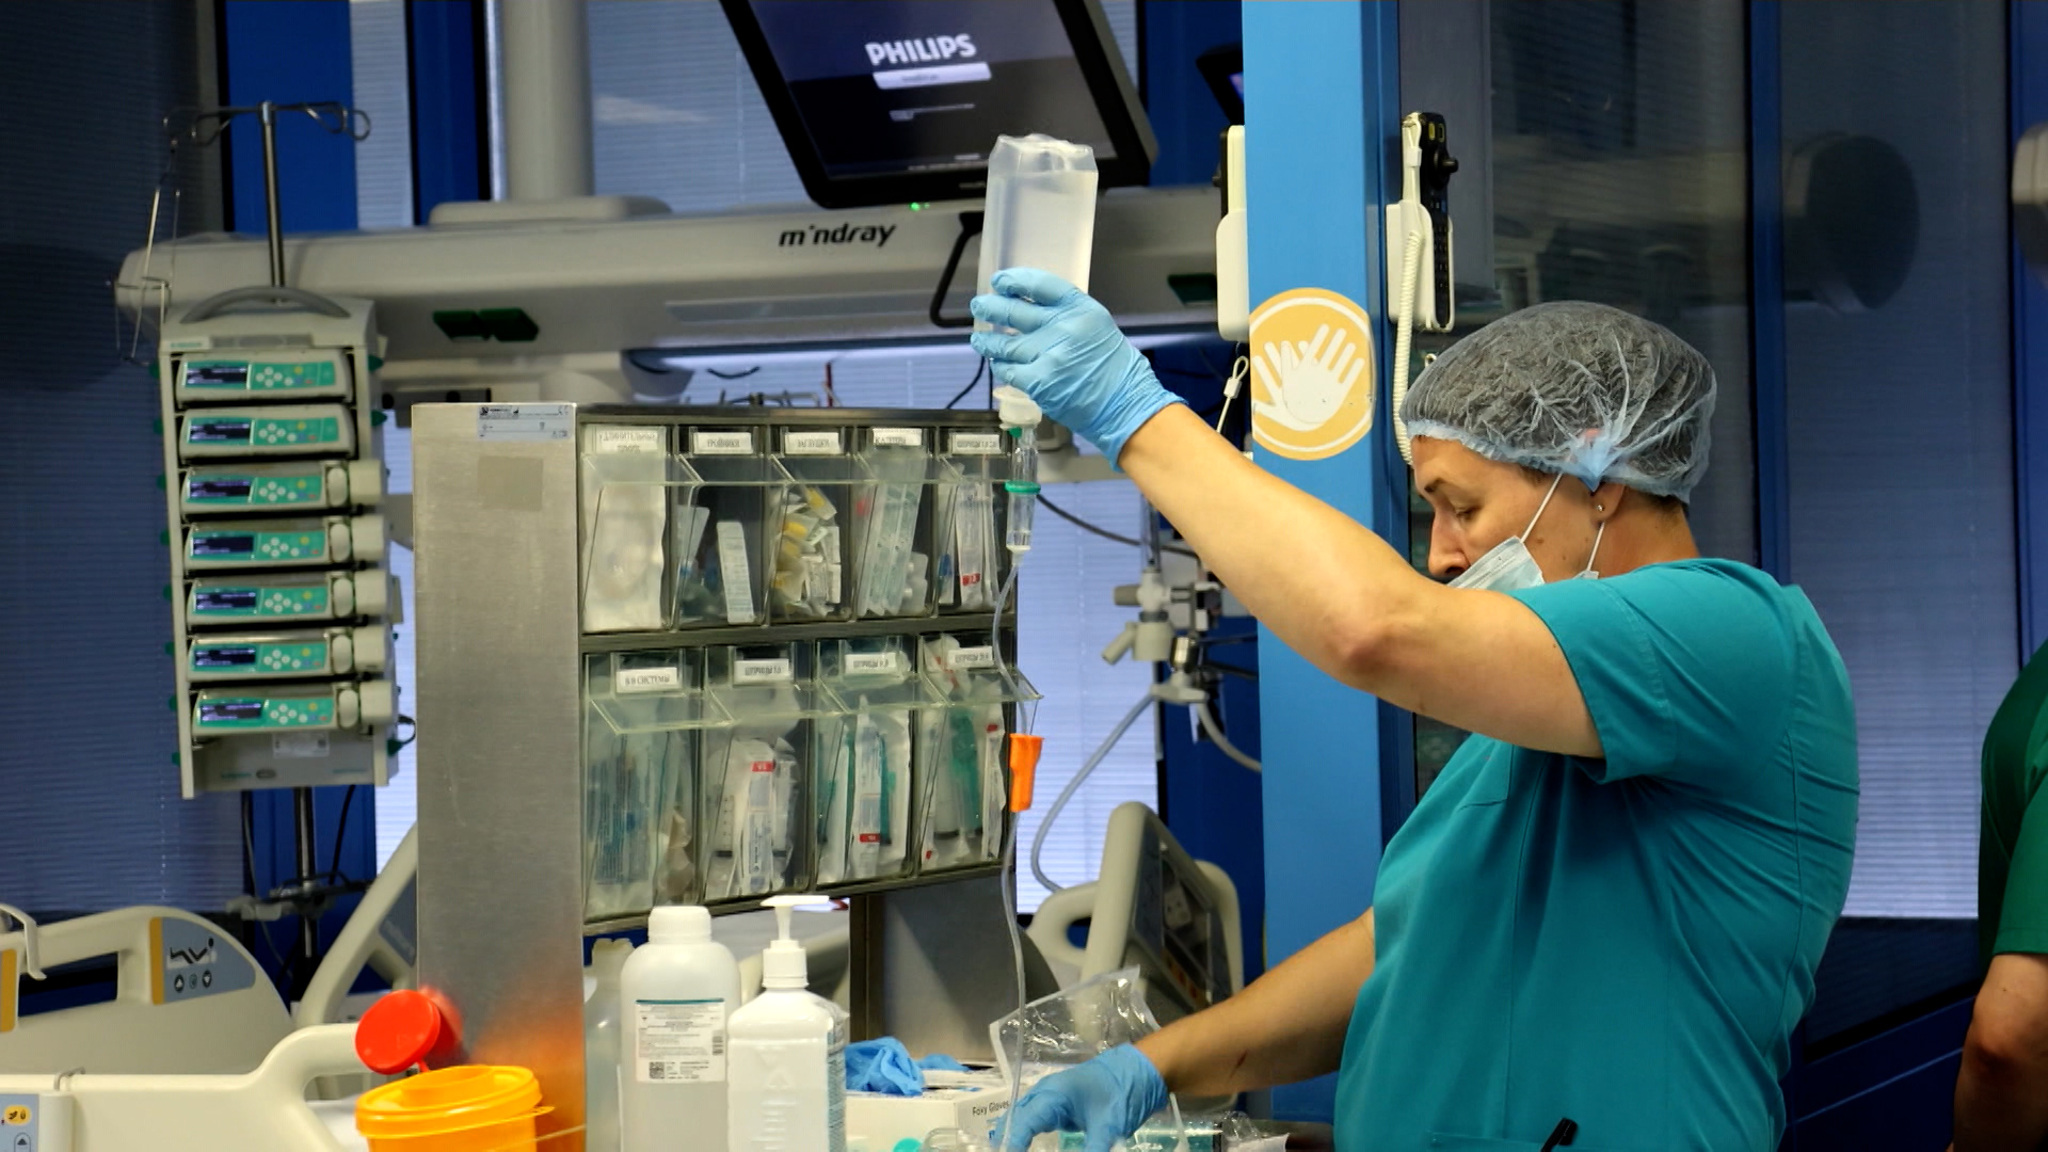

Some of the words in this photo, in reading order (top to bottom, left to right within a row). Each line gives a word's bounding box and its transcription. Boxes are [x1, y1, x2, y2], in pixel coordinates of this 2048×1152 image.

[865, 33, 977, 66] PHILIPS
[778, 222, 896, 248] mindray
[637, 674, 671, 686] СИСТЕМЫ
[972, 1105, 988, 1117] Foxy
[988, 1100, 1010, 1114] Gloves
